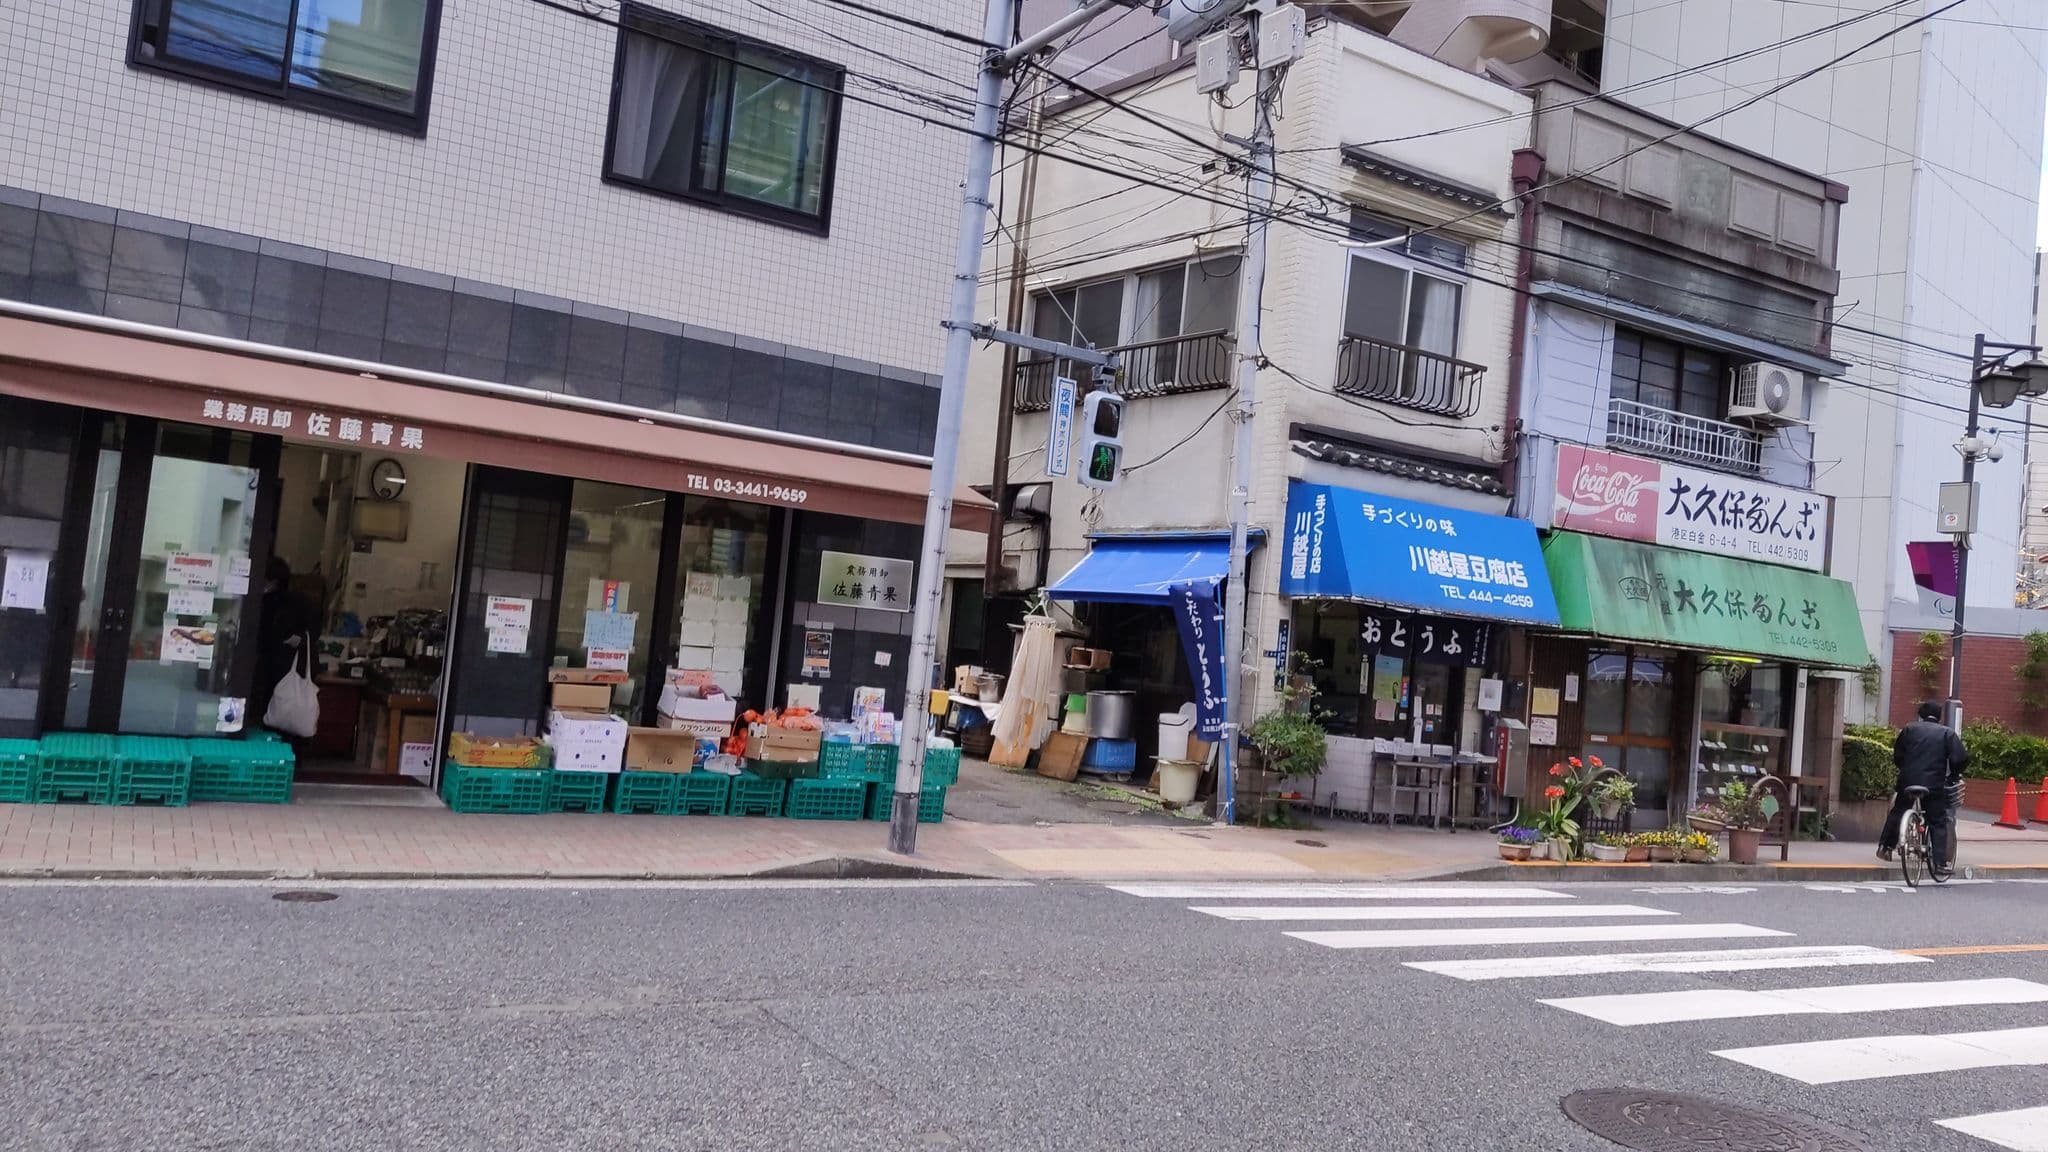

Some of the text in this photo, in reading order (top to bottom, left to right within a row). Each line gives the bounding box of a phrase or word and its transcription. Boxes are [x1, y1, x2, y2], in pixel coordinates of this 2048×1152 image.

[1060, 387, 1071, 418] 夜間
[203, 398, 423, 450] 業務用卸 佐藤青果
[687, 474, 807, 503] TEL 03-3441-9659
[1572, 464, 1643, 508] Coca-Cola
[1362, 503, 1457, 537] 手づくりの味
[1615, 507, 1637, 524] Coke
[1291, 511, 1311, 579] 川越屋
[1310, 493, 1326, 574] 手づくりの店
[1671, 526, 1705, 545] 港区白金
[1709, 532, 1737, 550] 6-4-4
[1748, 539, 1762, 554] TEL
[846, 564, 889, 580] 業務用卸
[1409, 545, 1529, 588] 川越屋豆腐店
[832, 580, 897, 602] 佐藤青果
[1440, 584, 1466, 600] TEL
[1185, 591, 1202, 639] こだわり
[1196, 642, 1219, 711] とうふ
[1361, 616, 1462, 655] おとうふ
[1768, 631, 1838, 653] TEL 442-5309
